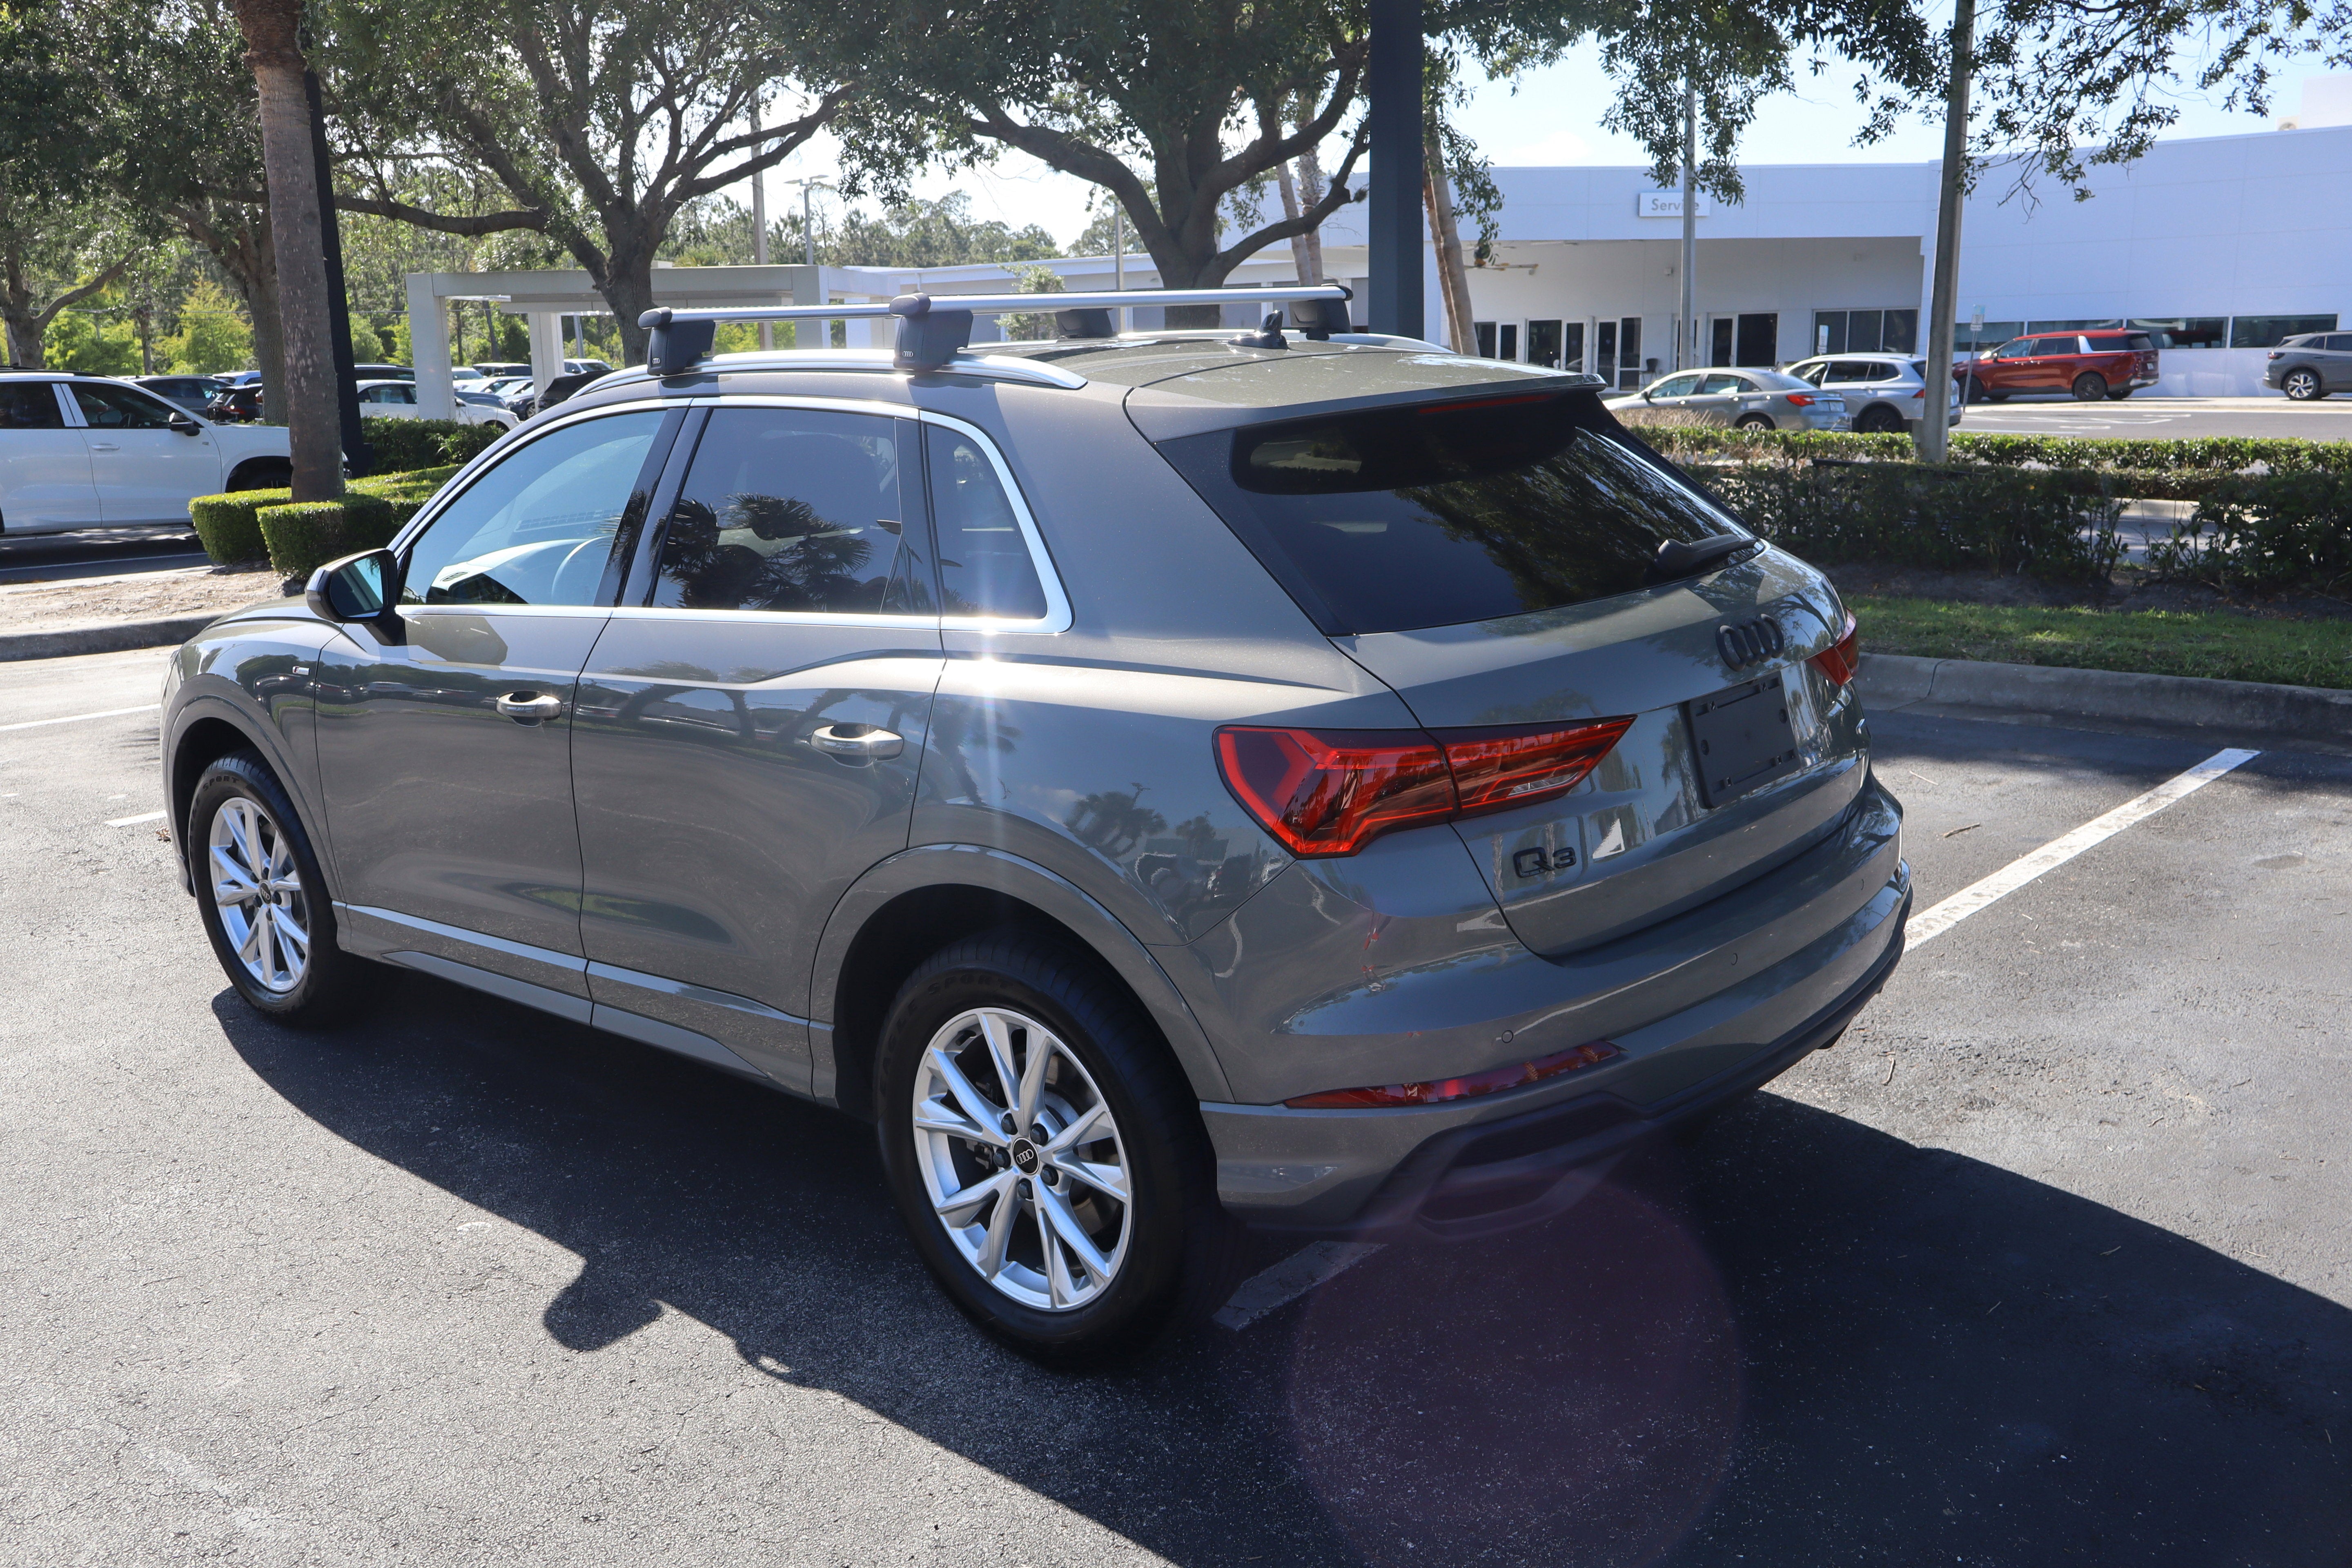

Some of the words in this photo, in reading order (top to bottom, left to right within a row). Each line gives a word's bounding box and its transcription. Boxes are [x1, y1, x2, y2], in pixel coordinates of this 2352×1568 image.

[1651, 198, 1699, 211] Servie
[203, 775, 240, 791] SPORT
[1513, 846, 1577, 878] Q3
[927, 973, 1014, 996] SPORT
